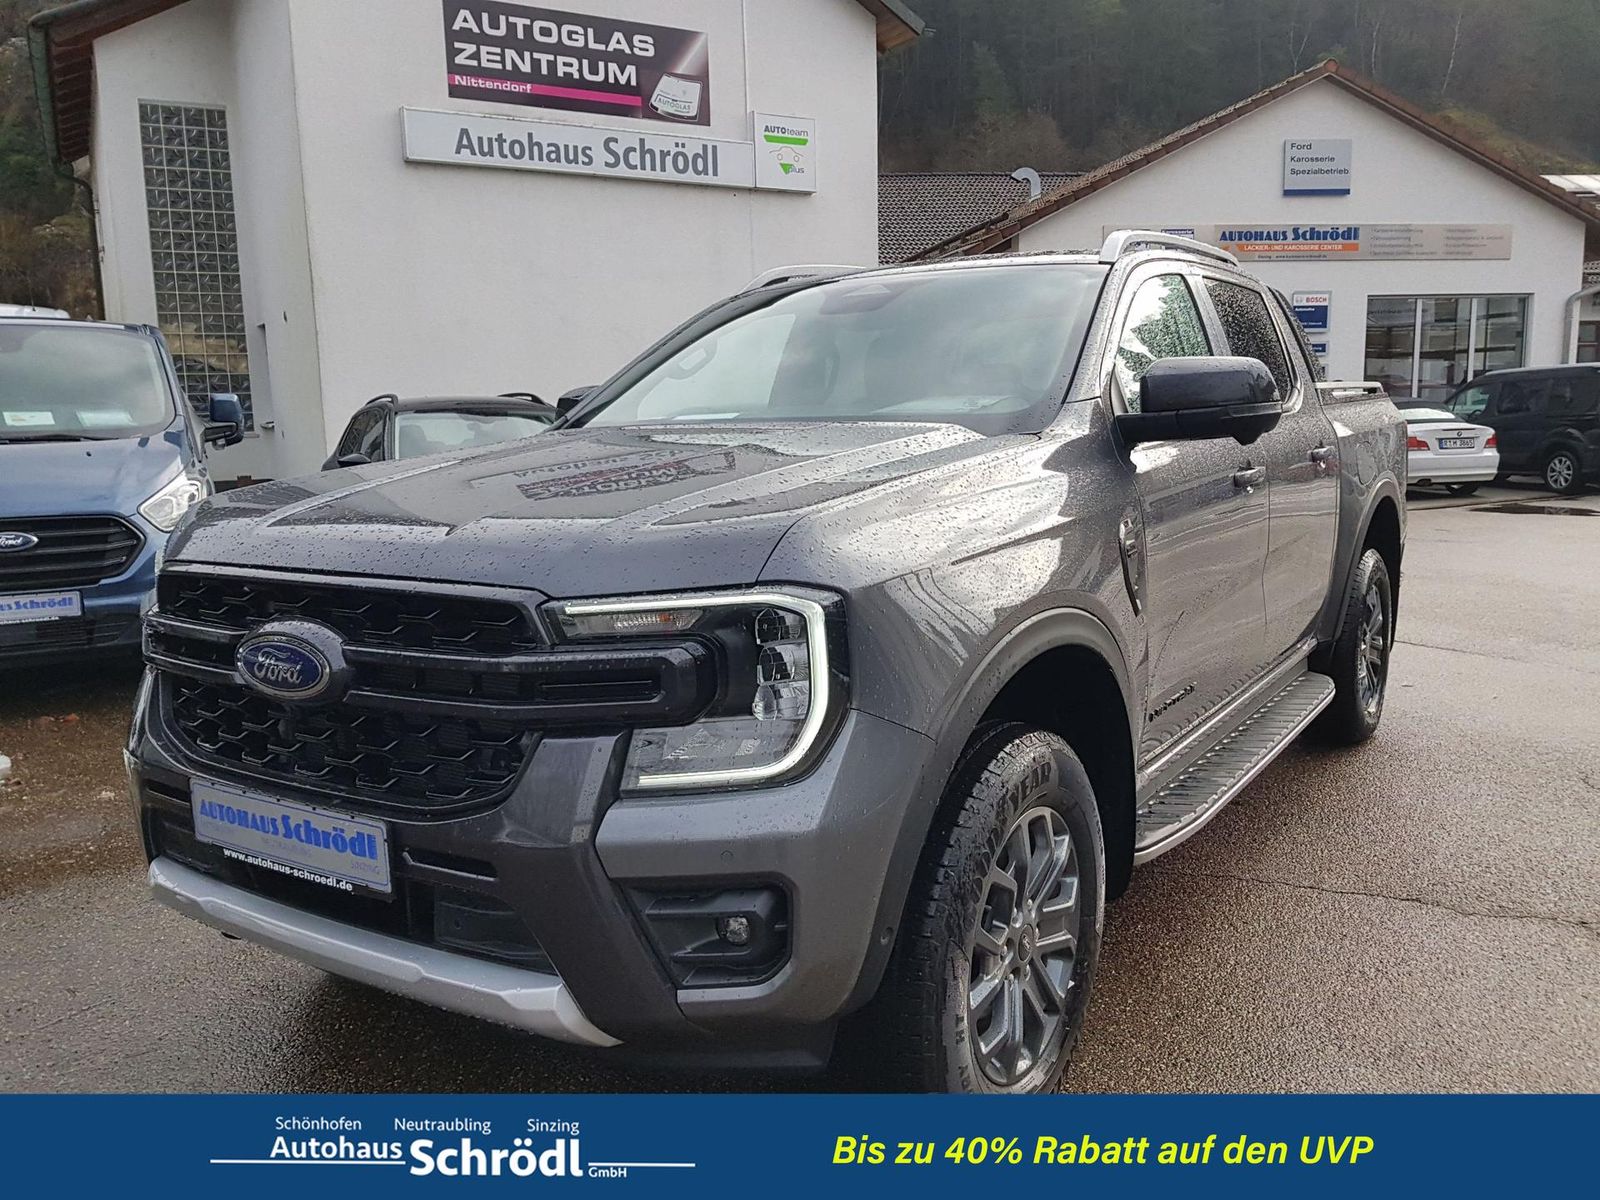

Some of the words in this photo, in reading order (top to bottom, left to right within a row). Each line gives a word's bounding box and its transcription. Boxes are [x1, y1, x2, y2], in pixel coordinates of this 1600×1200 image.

[452, 9, 656, 58] AUTOGLAS
[453, 41, 637, 86] ZENTRUM
[454, 74, 533, 94] Nittendorf
[657, 97, 691, 111] AUTOGLAS
[763, 124, 809, 138] AUTOteam
[454, 127, 594, 168] Autohaus
[603, 136, 719, 178] Schrödl
[1290, 155, 1336, 163] Karosserie
[1290, 168, 1349, 176] Spezialbetrieb
[1219, 231, 1288, 242] AUTOHAUS
[1291, 227, 1360, 241] Schrödl
[14, 597, 74, 610] Schrödl
[254, 647, 303, 684] Ford
[200, 800, 280, 836] AUTOHAUS
[281, 814, 379, 860] Schrödl
[223, 848, 353, 892] www.autohaus-schroedl.de
